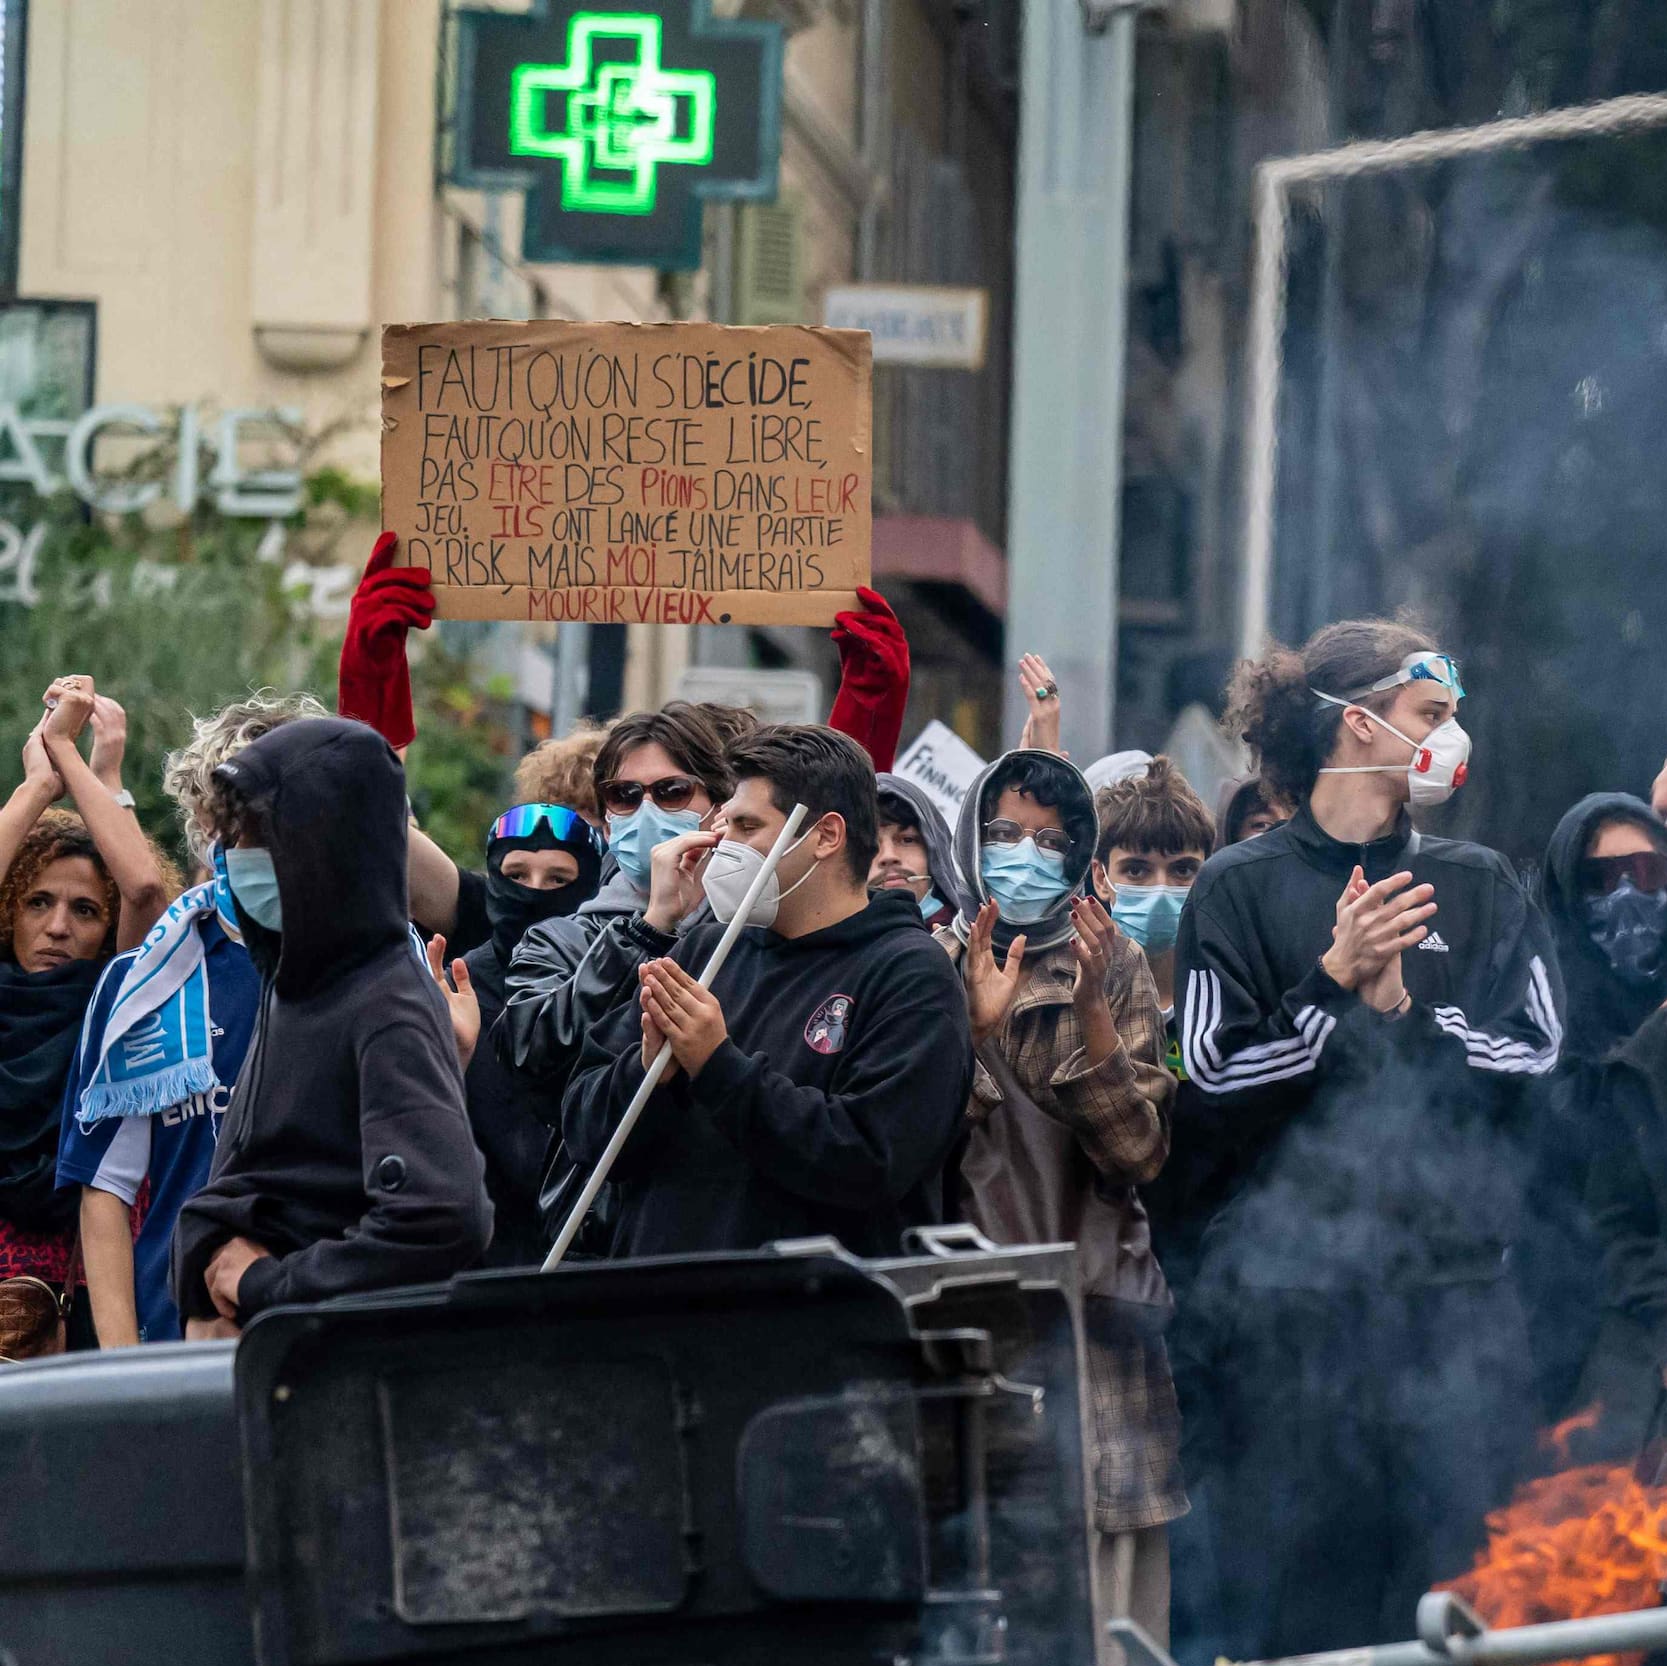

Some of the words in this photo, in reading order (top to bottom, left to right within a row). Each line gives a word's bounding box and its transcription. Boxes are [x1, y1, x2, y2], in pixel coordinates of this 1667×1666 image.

[419, 344, 530, 412] FAUT
[424, 413, 501, 461] FAUT
[602, 412, 707, 467] RESTE
[726, 414, 828, 469] LIBRE,
[420, 459, 479, 502] PAS
[489, 458, 554, 505] ÊTRE
[564, 464, 625, 505] DES
[641, 467, 709, 511] PIONS
[714, 469, 788, 514] DANS
[795, 473, 859, 514] LEUR
[415, 502, 469, 536] JEU.
[491, 505, 546, 539] ILS
[552, 508, 599, 545] ONT
[607, 506, 679, 545] LANCÉ
[688, 513, 745, 549] UNE
[757, 513, 844, 551] PARTIE
[528, 541, 596, 590] MAIS
[606, 542, 658, 591] MOI
[668, 548, 825, 592] J'AIMERAIS
[528, 585, 627, 622] MOURIR
[1418, 943, 1449, 952] adidas
